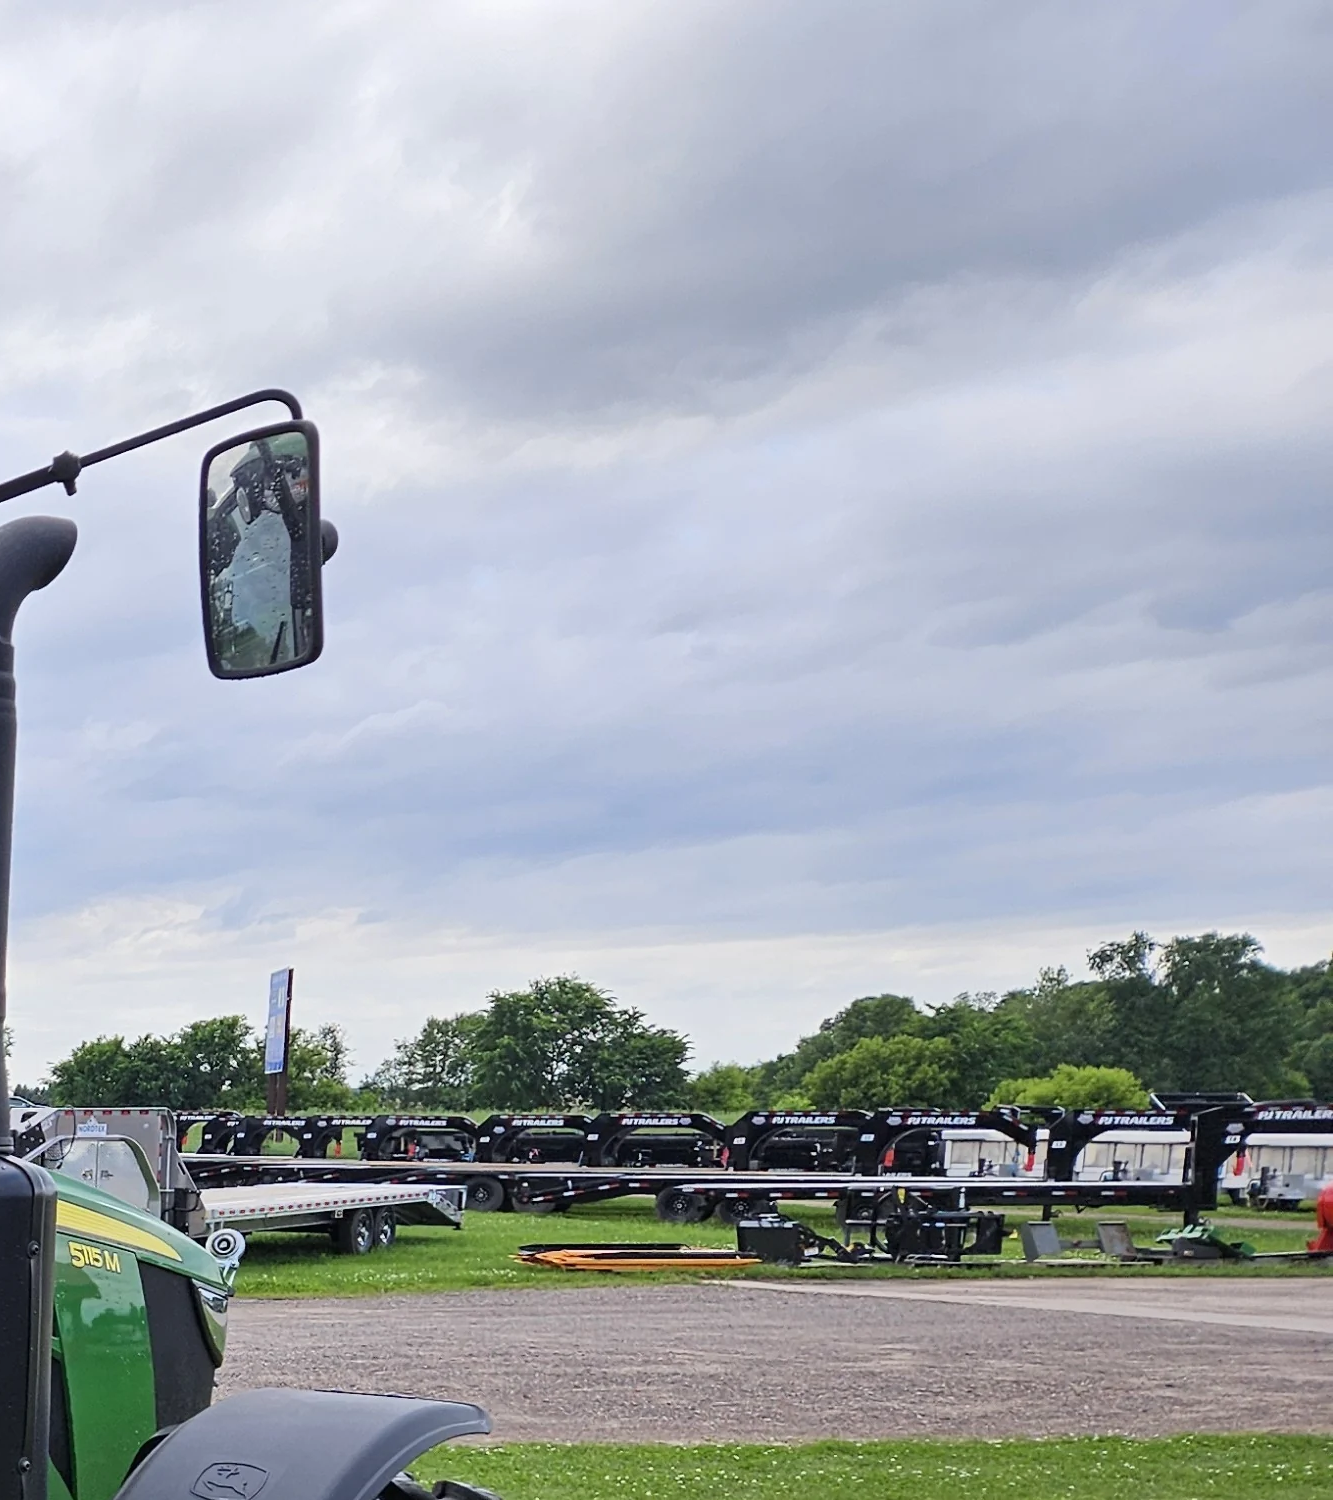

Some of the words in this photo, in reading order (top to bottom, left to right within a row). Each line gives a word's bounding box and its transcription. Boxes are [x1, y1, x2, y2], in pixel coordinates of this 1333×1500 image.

[1275, 1110, 1333, 1120] TRAILER
[785, 1116, 835, 1124] TRAILERS
[921, 1116, 976, 1125] TRAILERS
[1114, 1116, 1175, 1125] TRAILERS
